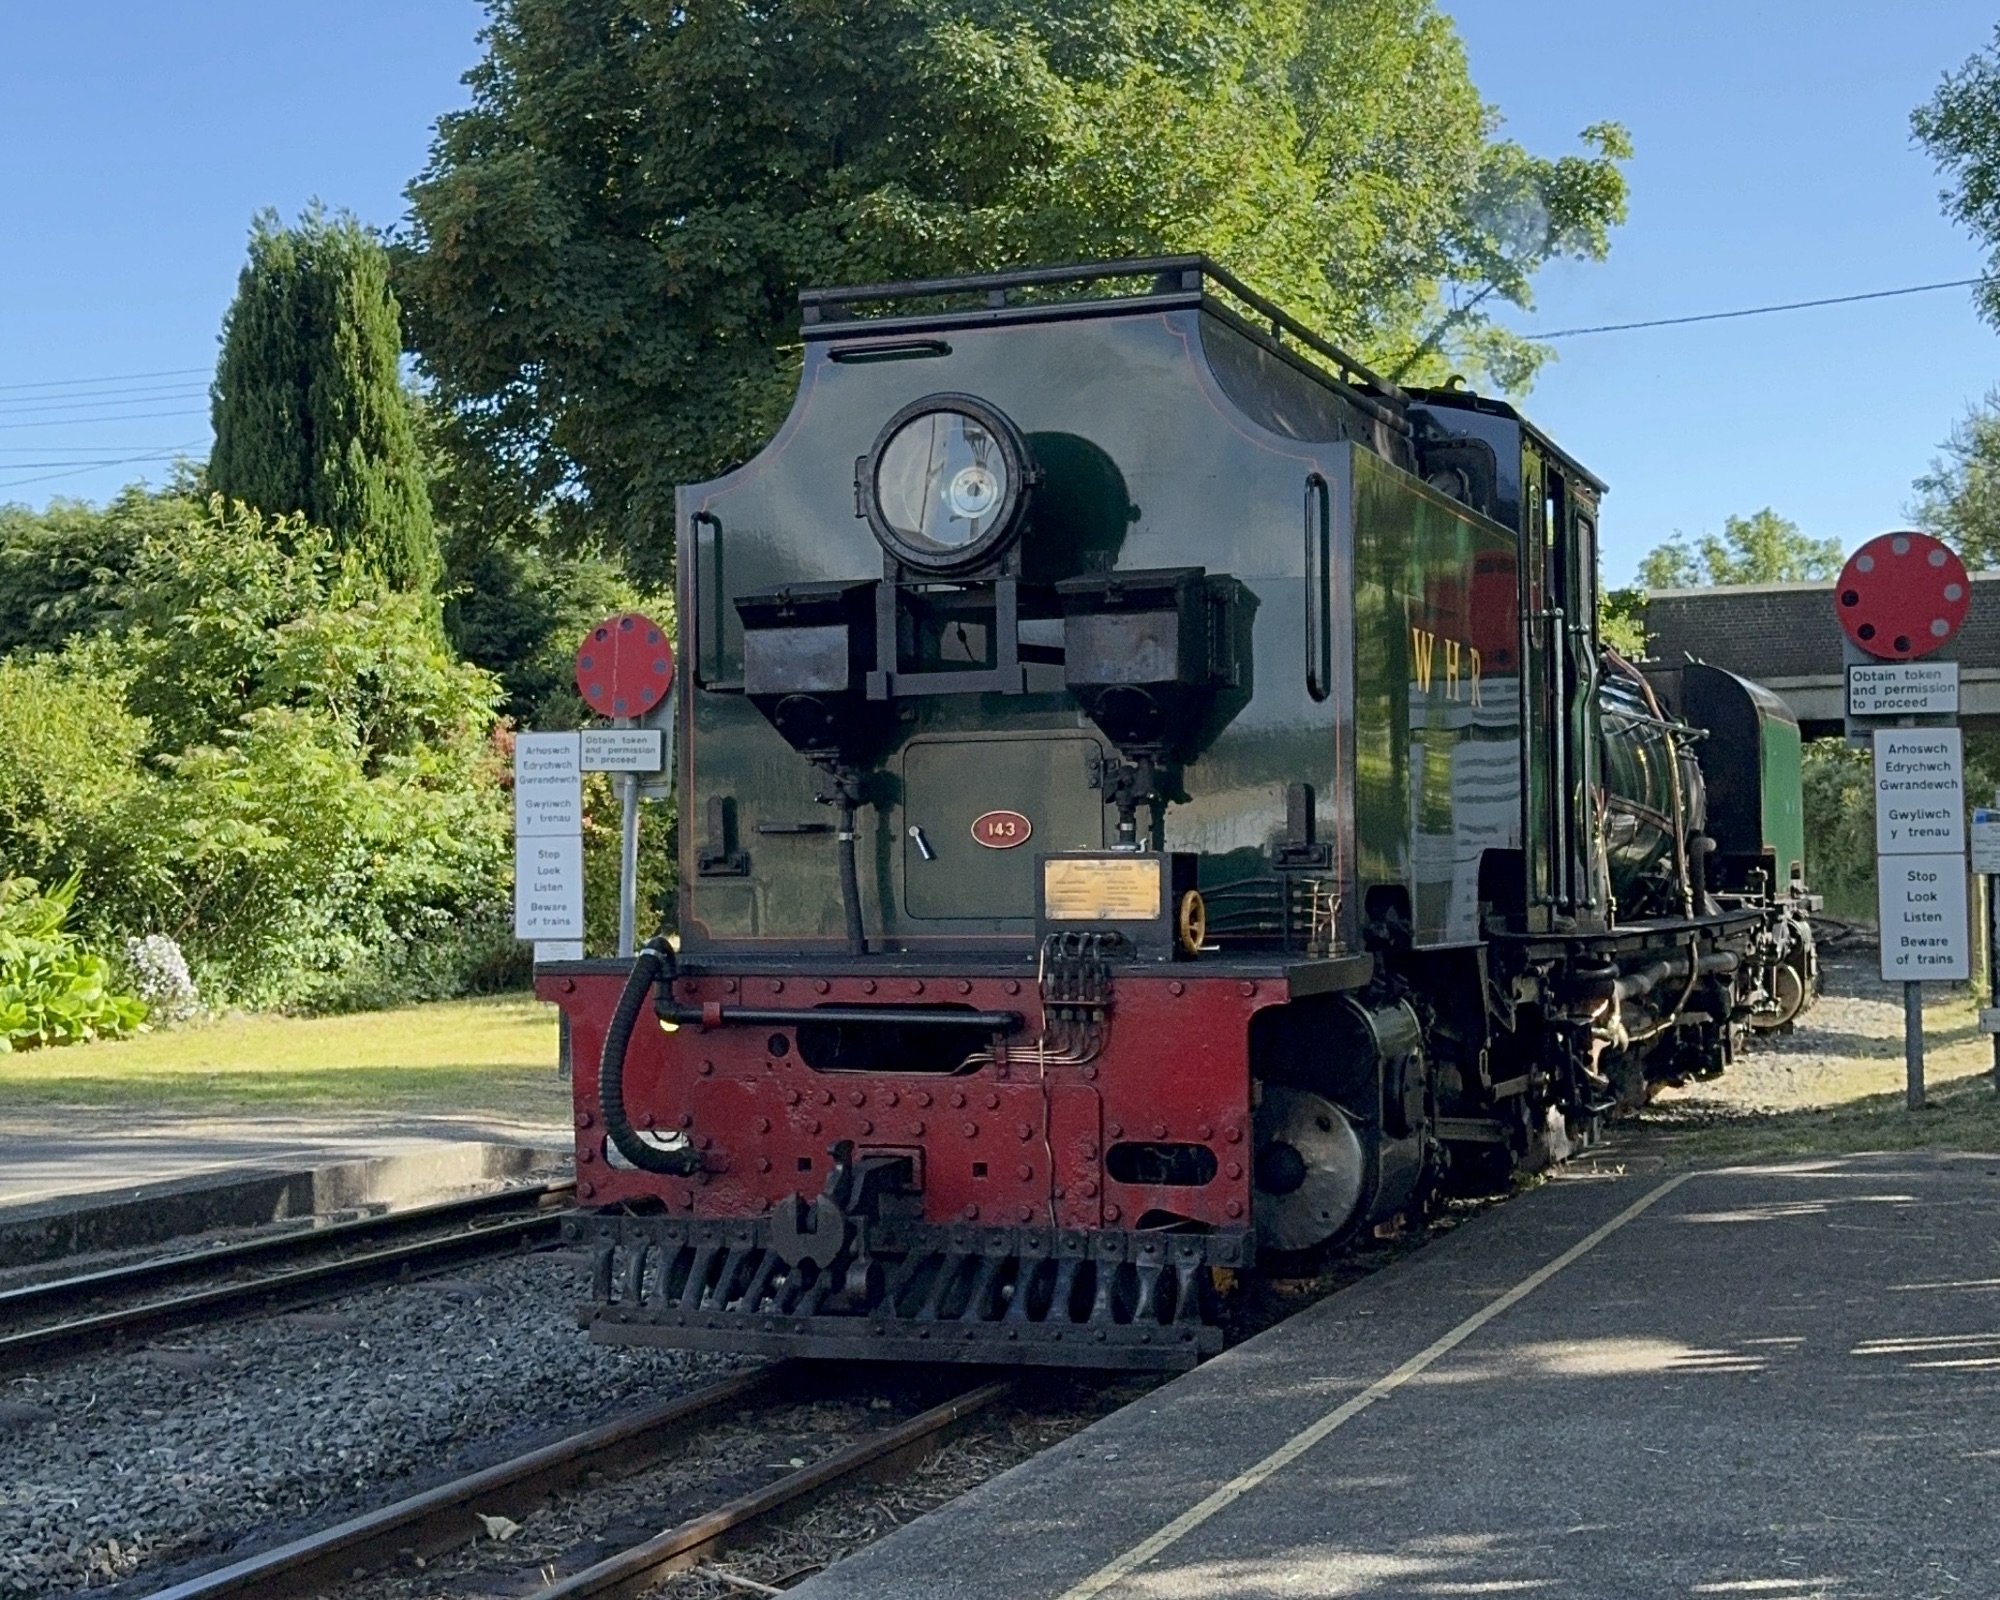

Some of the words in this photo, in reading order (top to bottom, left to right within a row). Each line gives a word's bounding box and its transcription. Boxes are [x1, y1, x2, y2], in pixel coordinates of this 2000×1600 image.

[1852, 671, 1896, 682] Obtain
[1905, 670, 1942, 681] token
[1852, 685, 1876, 696] and
[1884, 684, 1956, 697] permission
[1853, 699, 1866, 709] to
[1874, 697, 1928, 710] proceed
[585, 736, 616, 744] Obtain
[622, 736, 648, 744] token
[526, 746, 570, 755] Arhoswch
[585, 746, 601, 754] and
[608, 746, 656, 755] permission
[1888, 744, 1948, 755] Arhoswch
[585, 756, 594, 764] to
[601, 756, 637, 764] proceed
[524, 761, 572, 771] Edrychwch
[1886, 761, 1951, 774] Edrychwch
[519, 776, 577, 785] Gwrandewch
[1880, 780, 1958, 791] Gwrandewch
[526, 816, 532, 824] y
[540, 814, 571, 822] trenau
[1889, 809, 1950, 821] Gwyliwch
[988, 822, 1016, 836] 143
[1891, 829, 1898, 839] y
[1909, 827, 1950, 837] trenau
[538, 850, 560, 860] Stop
[538, 866, 560, 875] Look
[1907, 870, 1937, 883] Stop
[534, 883, 563, 892] Listen
[1907, 891, 1937, 902] Look
[531, 903, 567, 911] Beware
[527, 918, 537, 926] of
[543, 917, 571, 925] trains
[1904, 912, 1942, 922] Listen
[1900, 936, 1948, 947] Beware
[1896, 954, 1909, 965] of
[1917, 953, 1954, 964] trains
